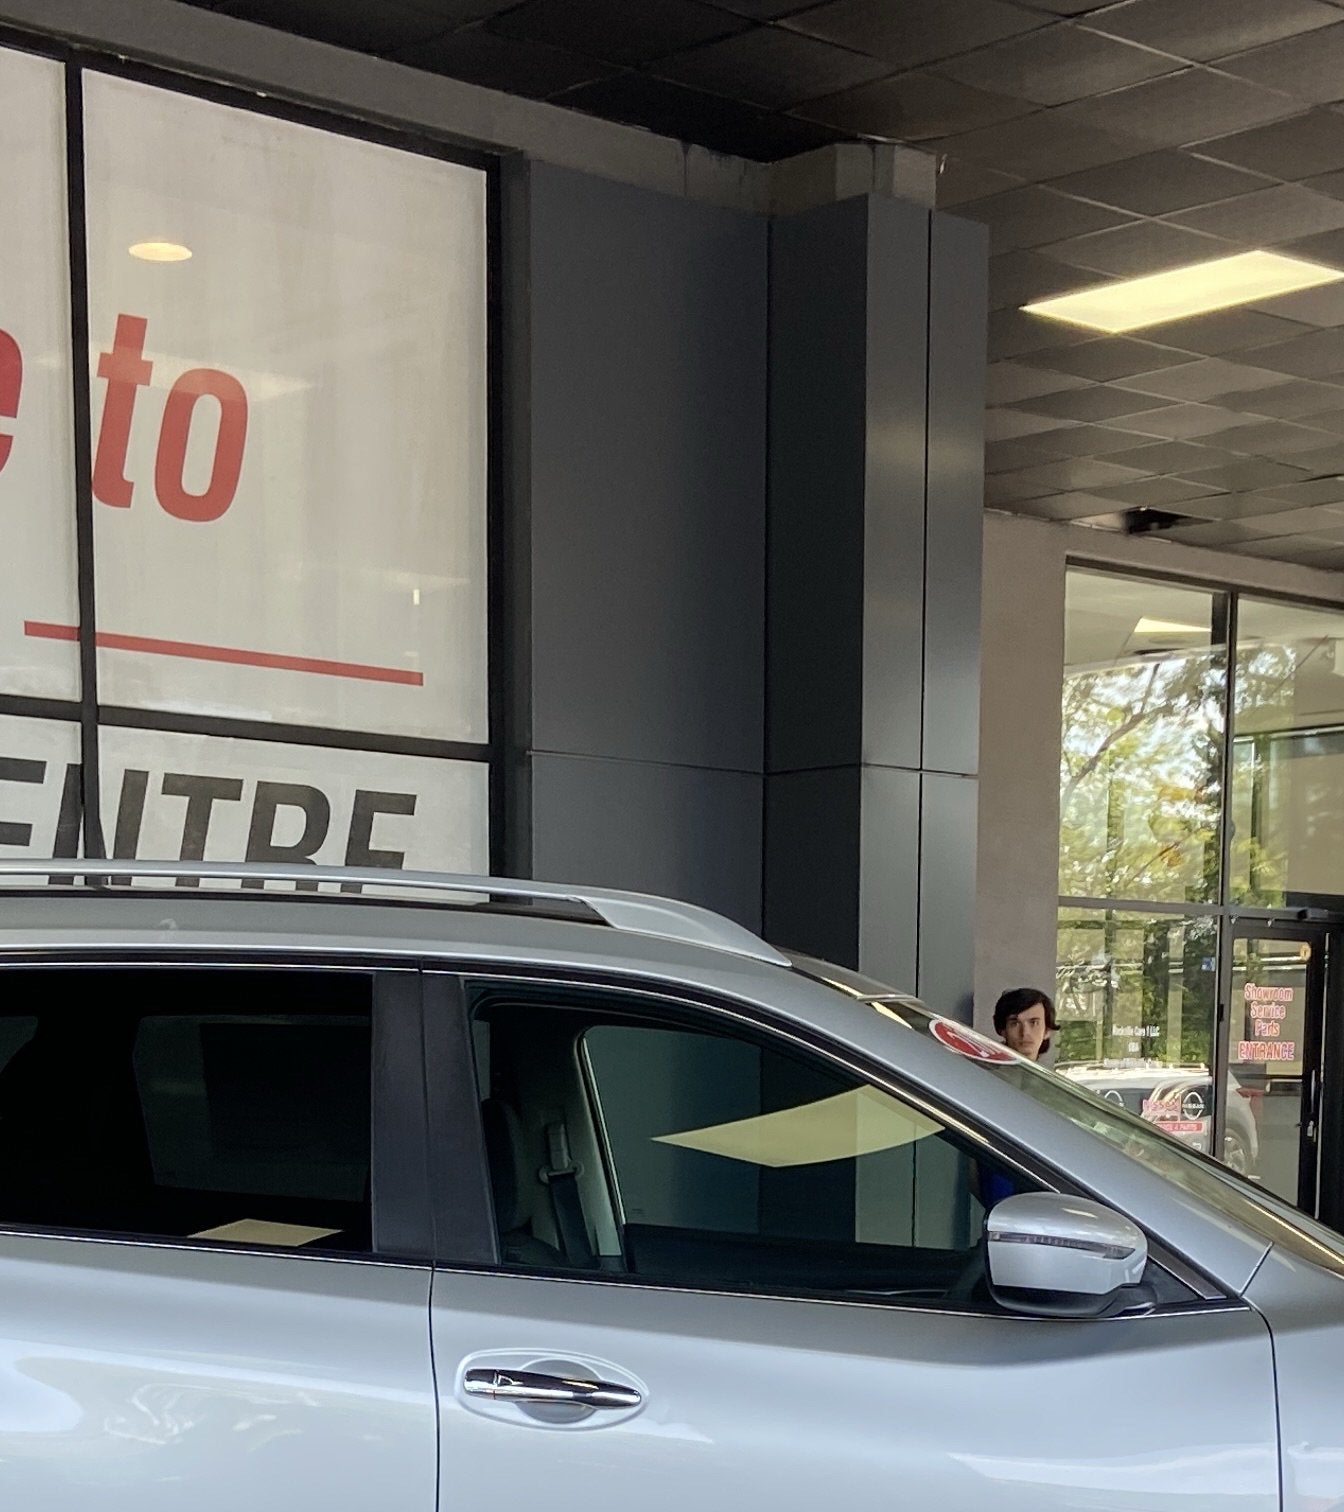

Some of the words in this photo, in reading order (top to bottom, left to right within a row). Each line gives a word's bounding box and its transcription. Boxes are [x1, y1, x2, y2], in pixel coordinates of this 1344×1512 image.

[91, 313, 249, 524] to
[1244, 983, 1294, 1001] Showroom
[1250, 1001, 1286, 1019] Service
[1255, 1019, 1280, 1036] Parts
[1238, 1041, 1295, 1060] ENTRANCE
